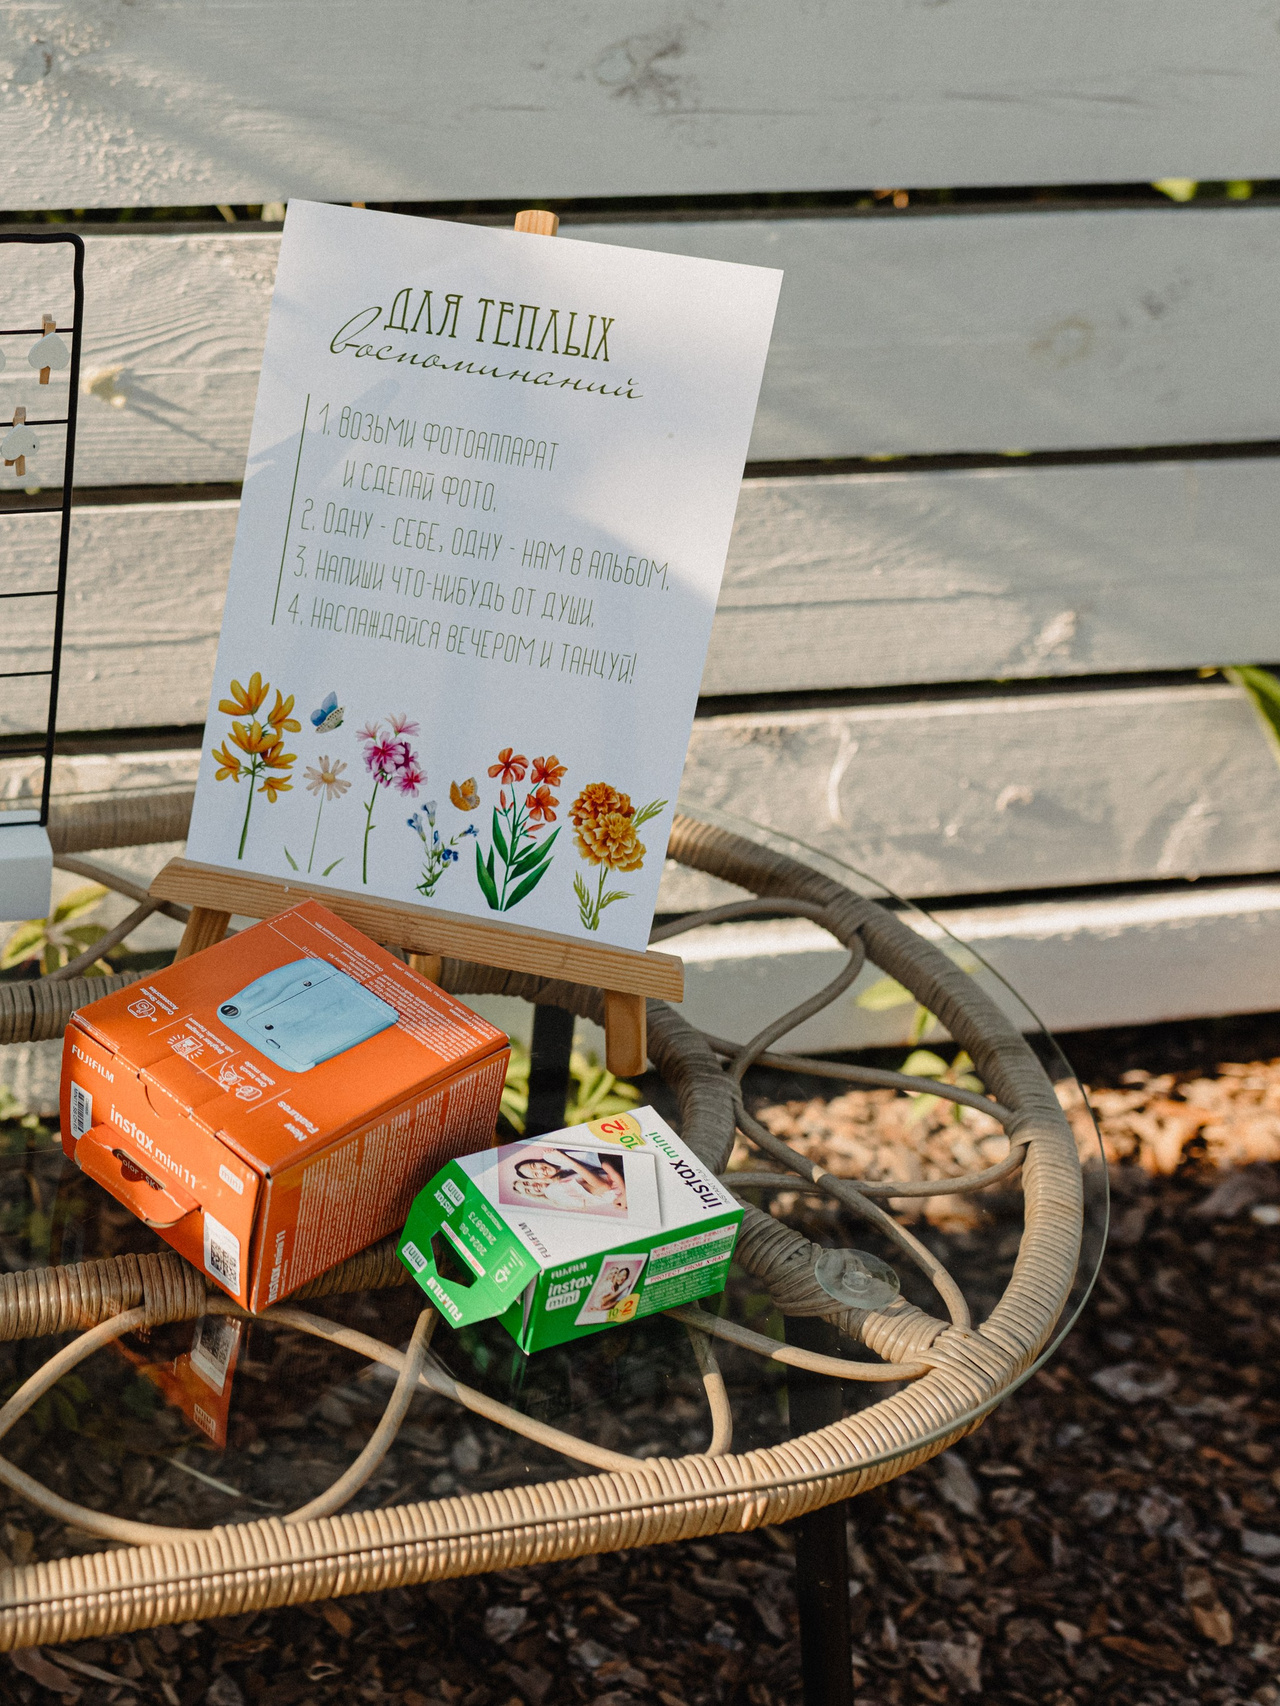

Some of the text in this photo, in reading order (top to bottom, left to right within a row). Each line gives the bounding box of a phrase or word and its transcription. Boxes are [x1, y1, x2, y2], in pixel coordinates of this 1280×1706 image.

[383, 287, 615, 362] ДЛЯ ТЕПЛЫХ
[329, 306, 644, 399] воспоминаний
[318, 402, 559, 471] 1. ВОЗЬМИ ФОТОАППАРАТ
[342, 459, 356, 488] И
[361, 462, 435, 501] СДЕЛАЙ
[300, 498, 315, 531] 2.
[323, 501, 373, 540] ОДНУ
[392, 517, 443, 552] СЕБЕ,
[451, 527, 503, 562] ОДНУ
[521, 538, 566, 572] НАМ
[570, 547, 583, 576] В
[588, 550, 669, 591] АЛЬБОМ.
[293, 544, 594, 628] 3. НАПИШИ ЧТО-НИБУДЬ ОТ ДУШИ.
[287, 593, 638, 685] 4. НАСЛАЖДАЙСЯ ВЕЧЕРОМ И ТАНЦУЙ!
[71, 1044, 115, 1083] FUJIFILM
[110, 1103, 154, 1153] instax
[277, 1100, 320, 1134] Features
[283, 1122, 308, 1142] New
[645, 1131, 680, 1159] mini
[433, 1189, 455, 1217] instax
[443, 1181, 463, 1203] mini
[669, 1159, 723, 1210] instax
[403, 1244, 426, 1268] mini
[518, 1222, 551, 1259] FUJIFILM
[548, 1274, 594, 1297] instax
[551, 1261, 587, 1280] FUJIFILM
[650, 1269, 681, 1282] PROTECT
[426, 1276, 464, 1323] FUJIFILM
[548, 1291, 578, 1309] mini
